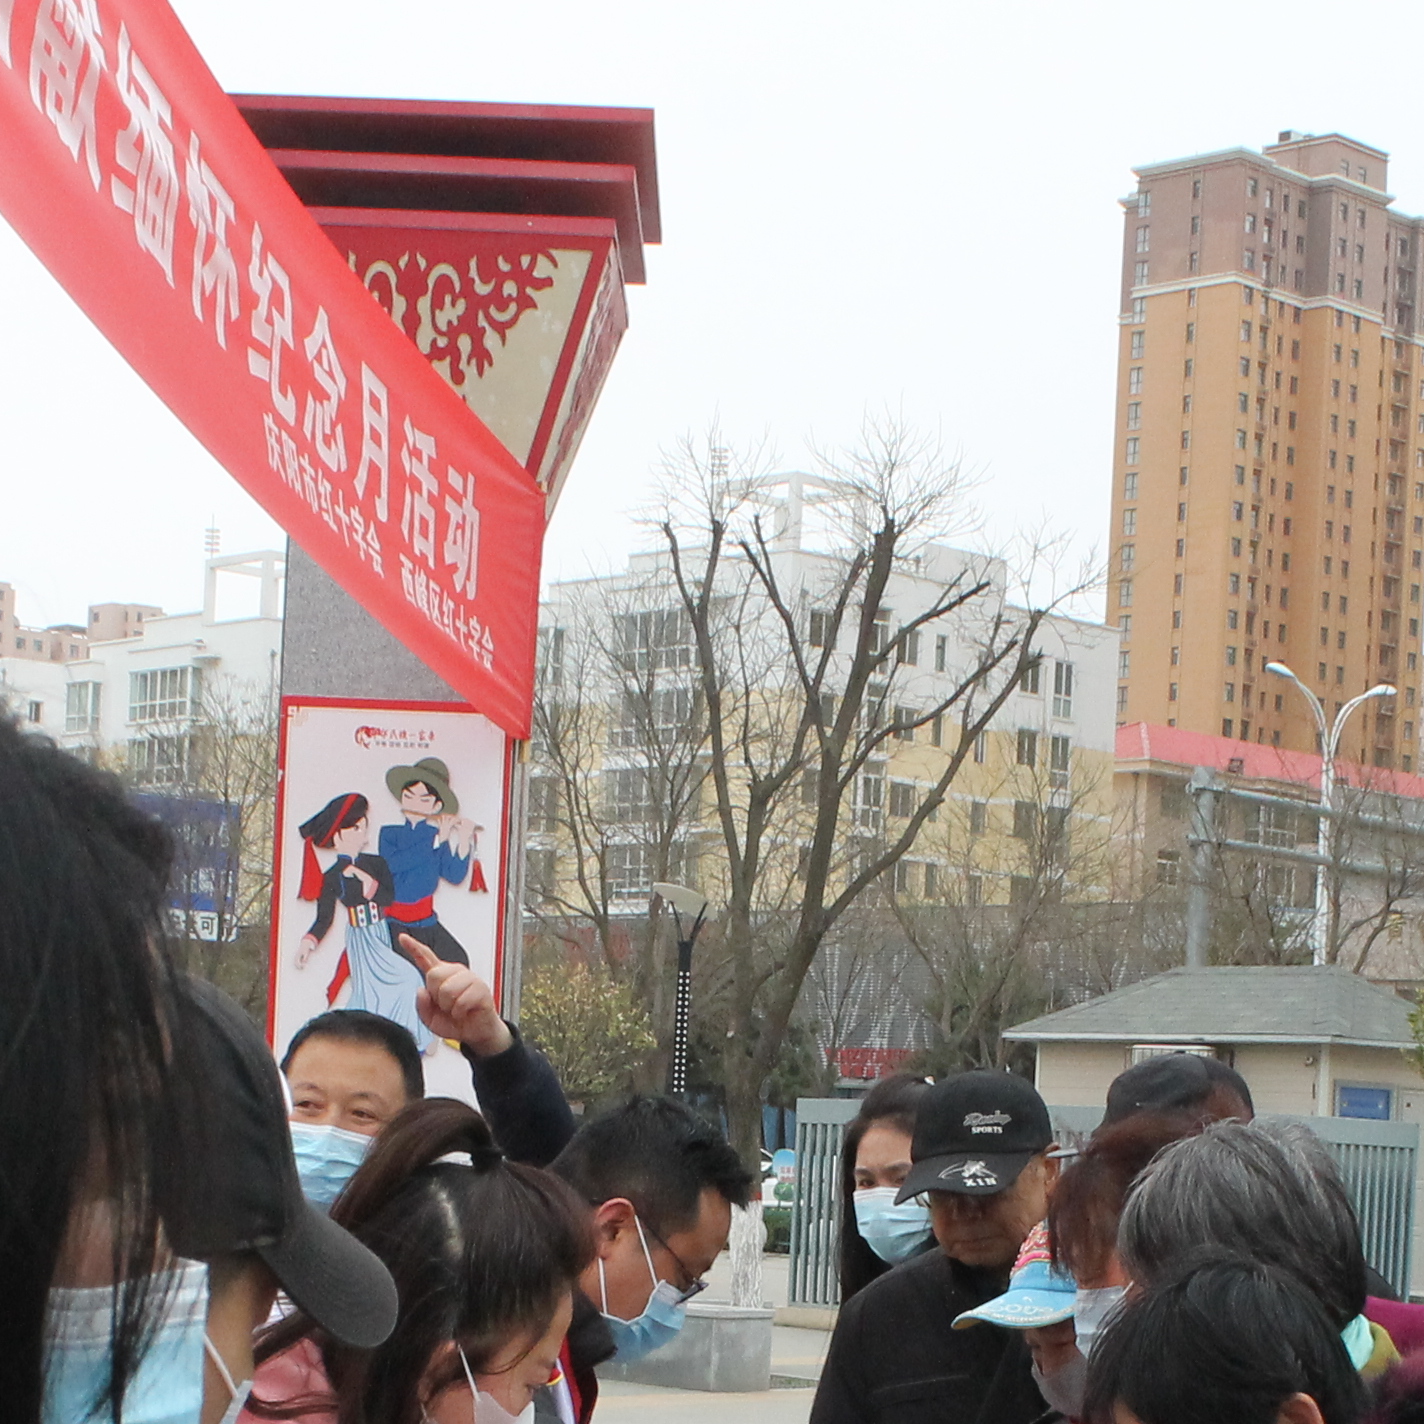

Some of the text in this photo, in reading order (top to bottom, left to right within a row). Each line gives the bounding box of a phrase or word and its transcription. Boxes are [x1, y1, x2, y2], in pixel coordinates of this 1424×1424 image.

[263, 412, 494, 672] 庆阳市红十字会 西峰区红十字会
[971, 1125, 1004, 1135] SPORTS
